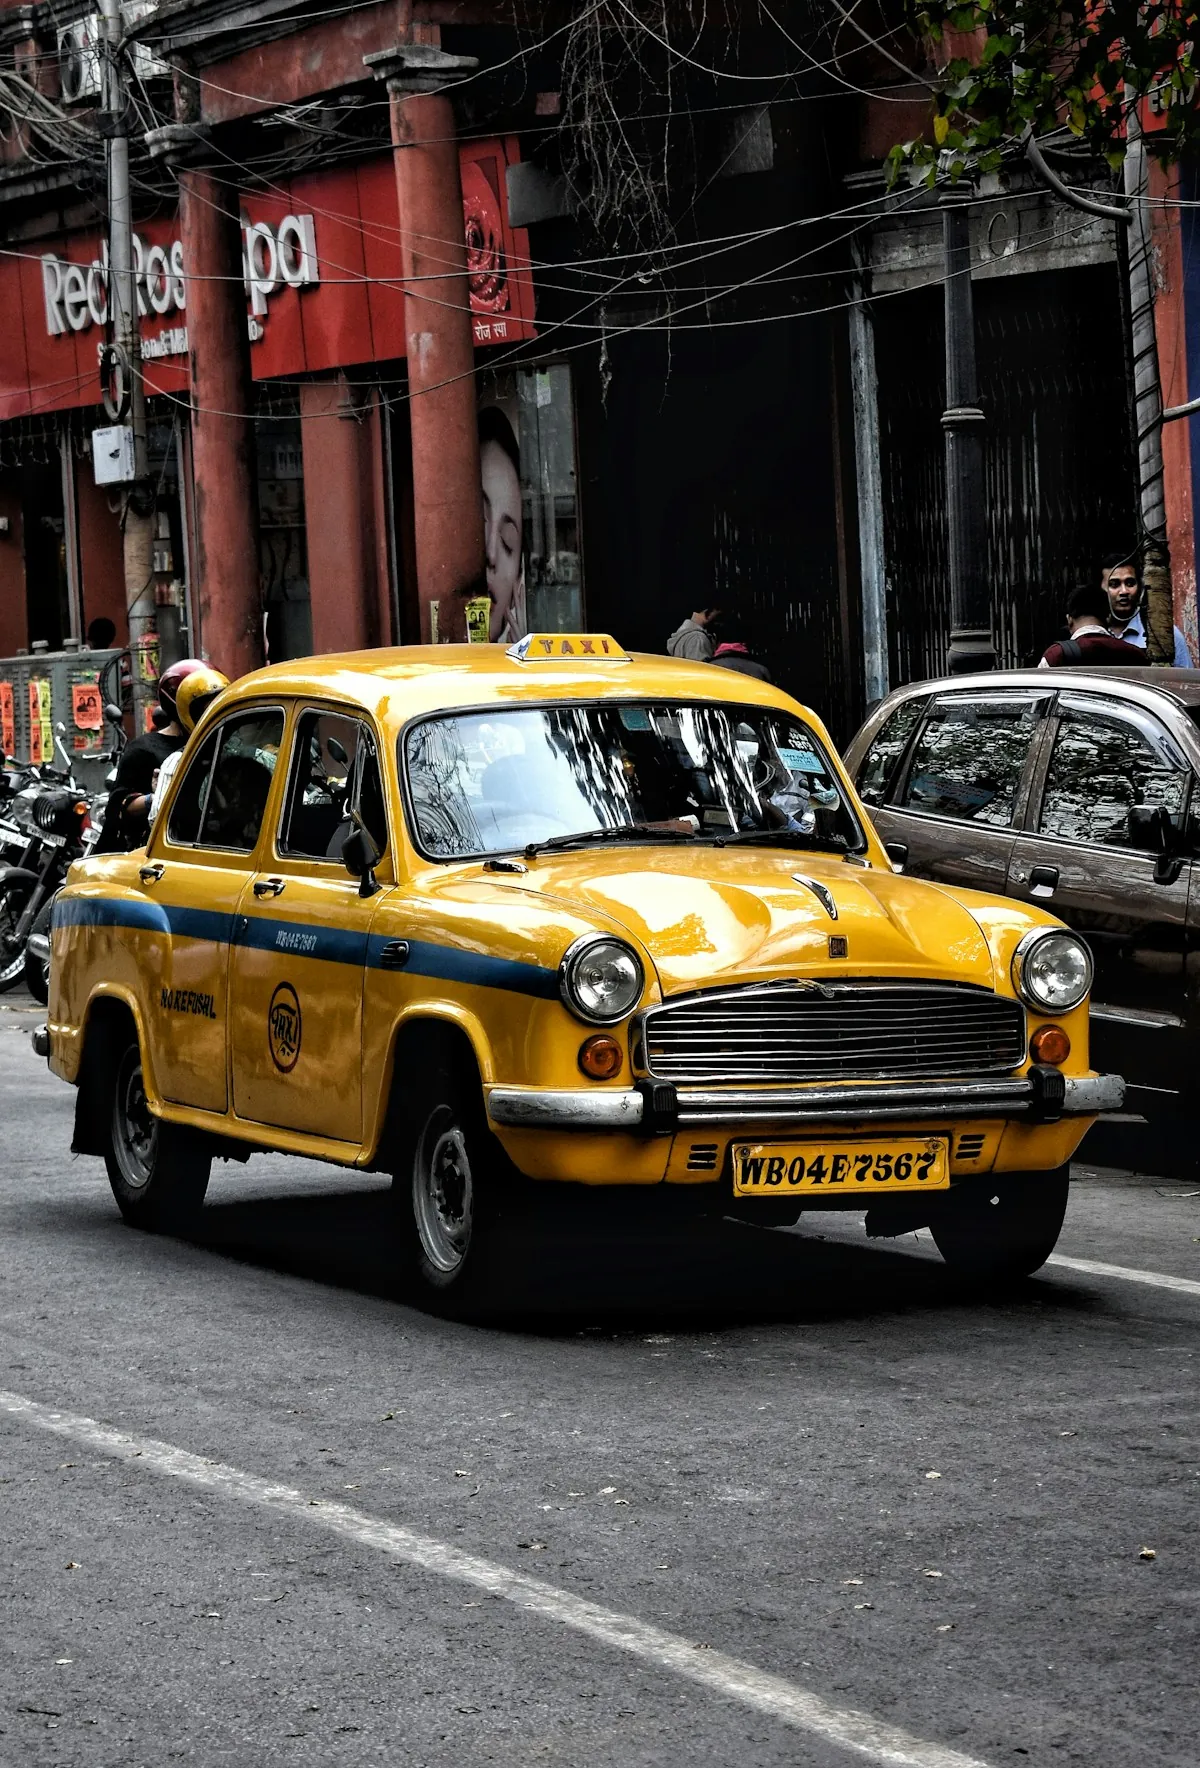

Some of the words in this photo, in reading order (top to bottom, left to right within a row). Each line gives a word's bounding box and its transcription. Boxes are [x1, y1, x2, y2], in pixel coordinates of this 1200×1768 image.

[42, 239, 115, 336] Red
[132, 233, 187, 316] Ros
[240, 206, 319, 315] pa
[474, 320, 491, 340] रोज
[492, 321, 507, 337] स्पा
[539, 640, 610, 654] TAXI
[161, 988, 173, 1010] NO
[271, 1003, 298, 1044] TAXI
